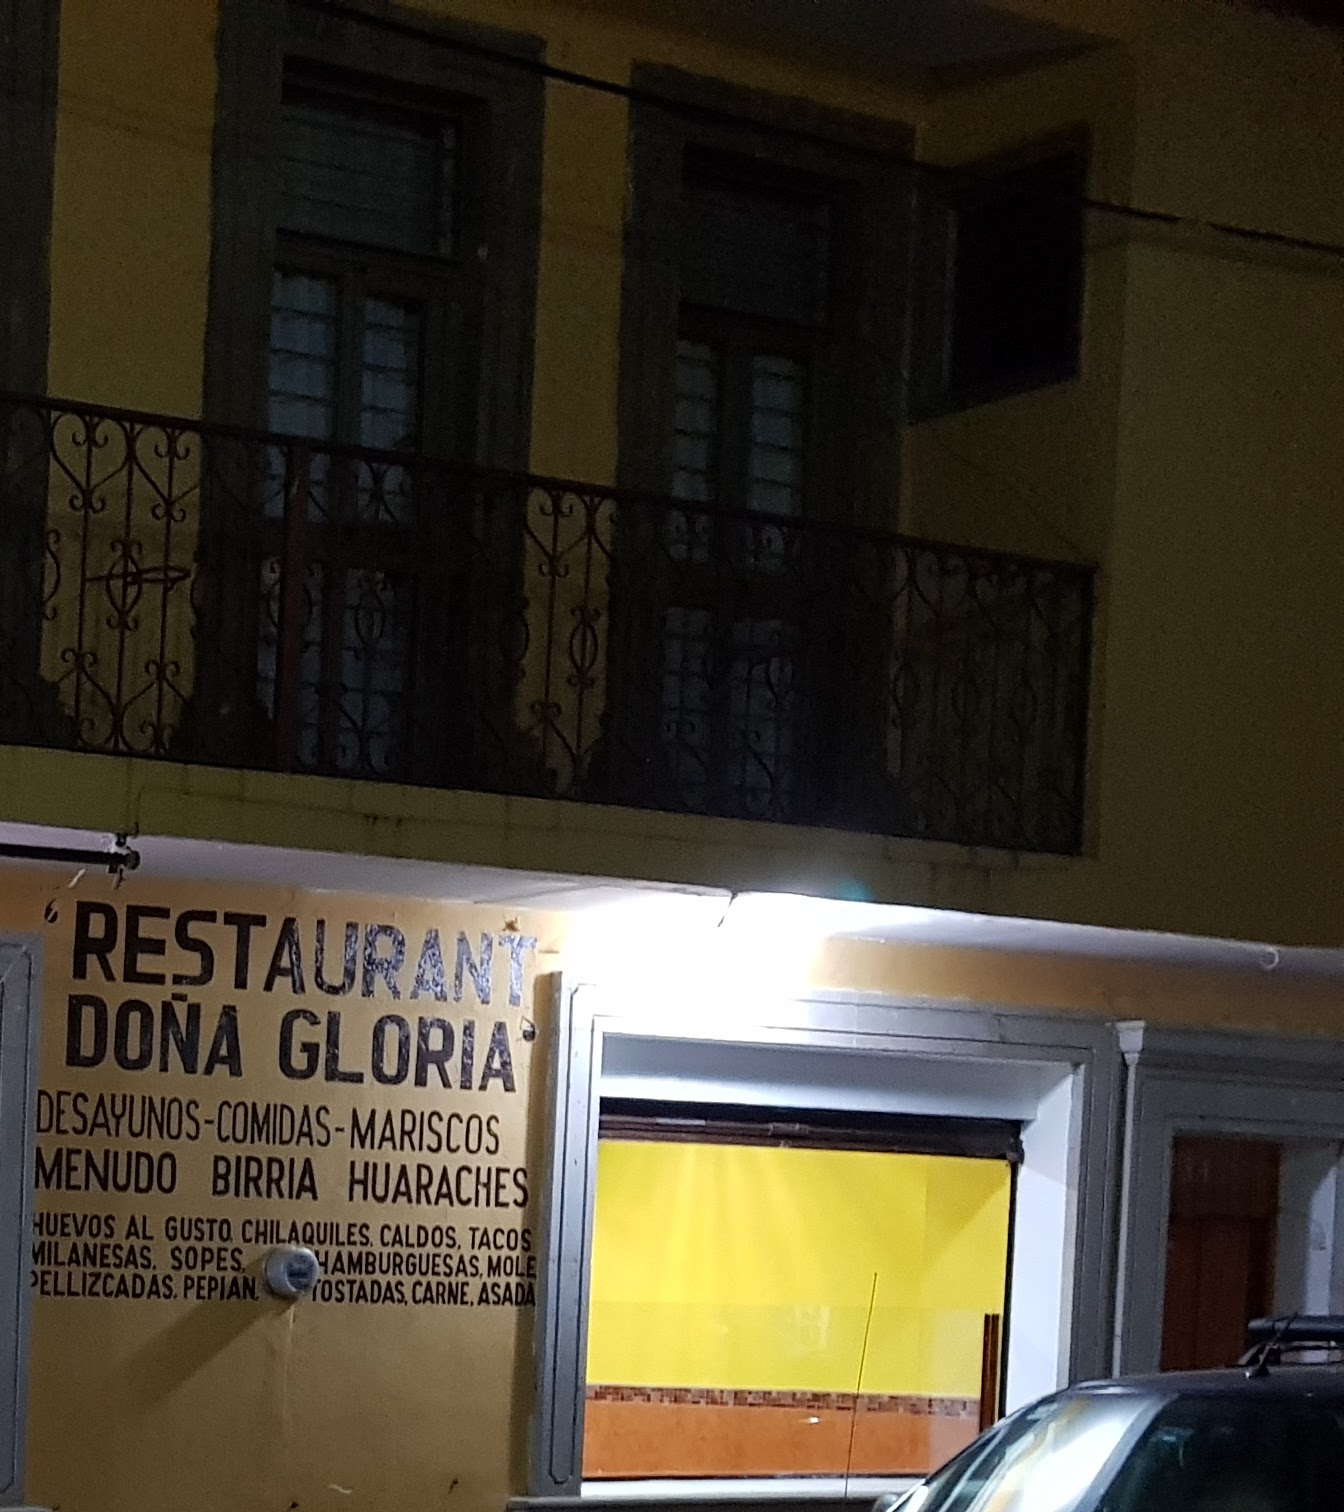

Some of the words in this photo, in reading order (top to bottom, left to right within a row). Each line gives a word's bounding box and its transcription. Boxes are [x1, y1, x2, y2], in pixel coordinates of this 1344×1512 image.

[65, 993, 243, 1078] DOÑA
[278, 1009, 516, 1093] GLORIA
[34, 1146, 177, 1195] MENUDO
[212, 1154, 318, 1200] BIRRIA
[348, 1160, 529, 1208] HUARACHES
[32, 1211, 116, 1240] HUEVOS
[125, 1214, 154, 1240] AL
[468, 1227, 532, 1251] TACOS
[487, 1255, 537, 1278] MOLE
[477, 1282, 536, 1307] ASADA
